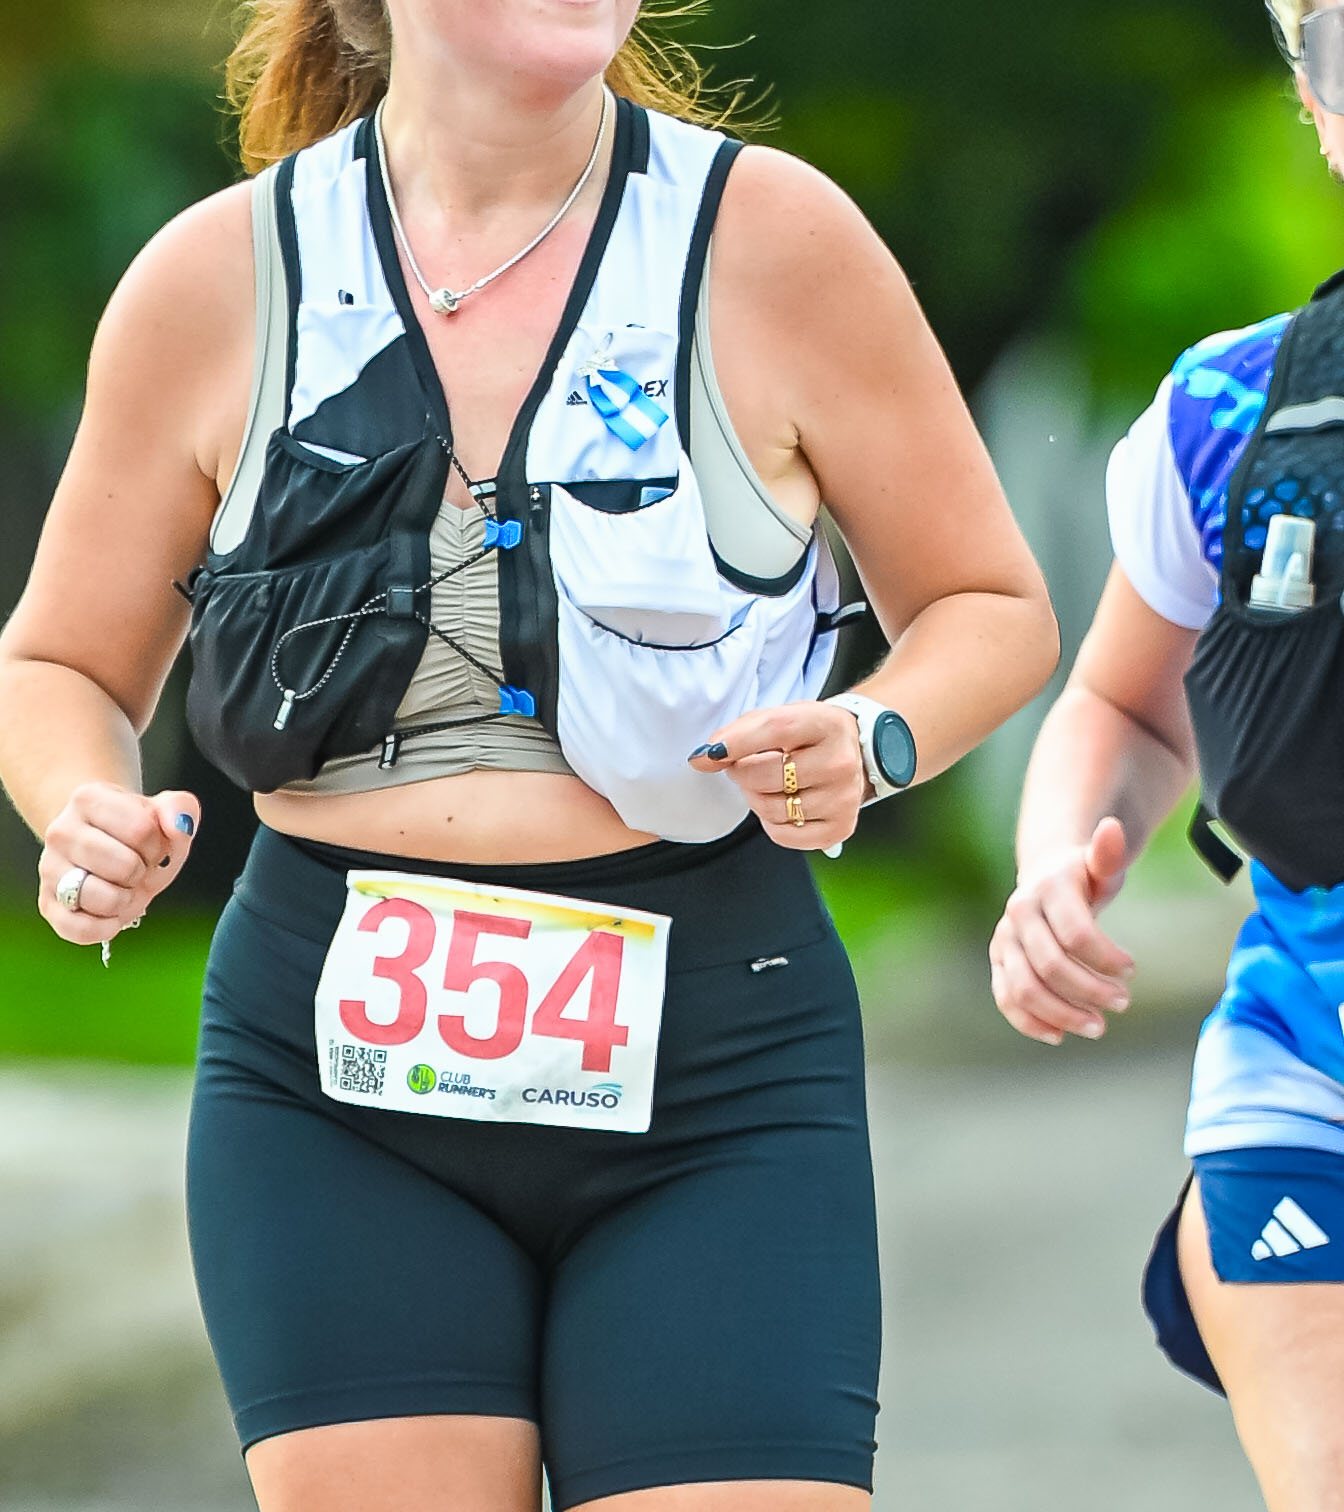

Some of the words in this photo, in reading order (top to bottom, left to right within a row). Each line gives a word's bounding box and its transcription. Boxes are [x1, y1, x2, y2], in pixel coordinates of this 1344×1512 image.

[338, 897, 629, 1073] 354
[440, 1070, 471, 1085] CLUB
[521, 1087, 619, 1109] CARUSO
